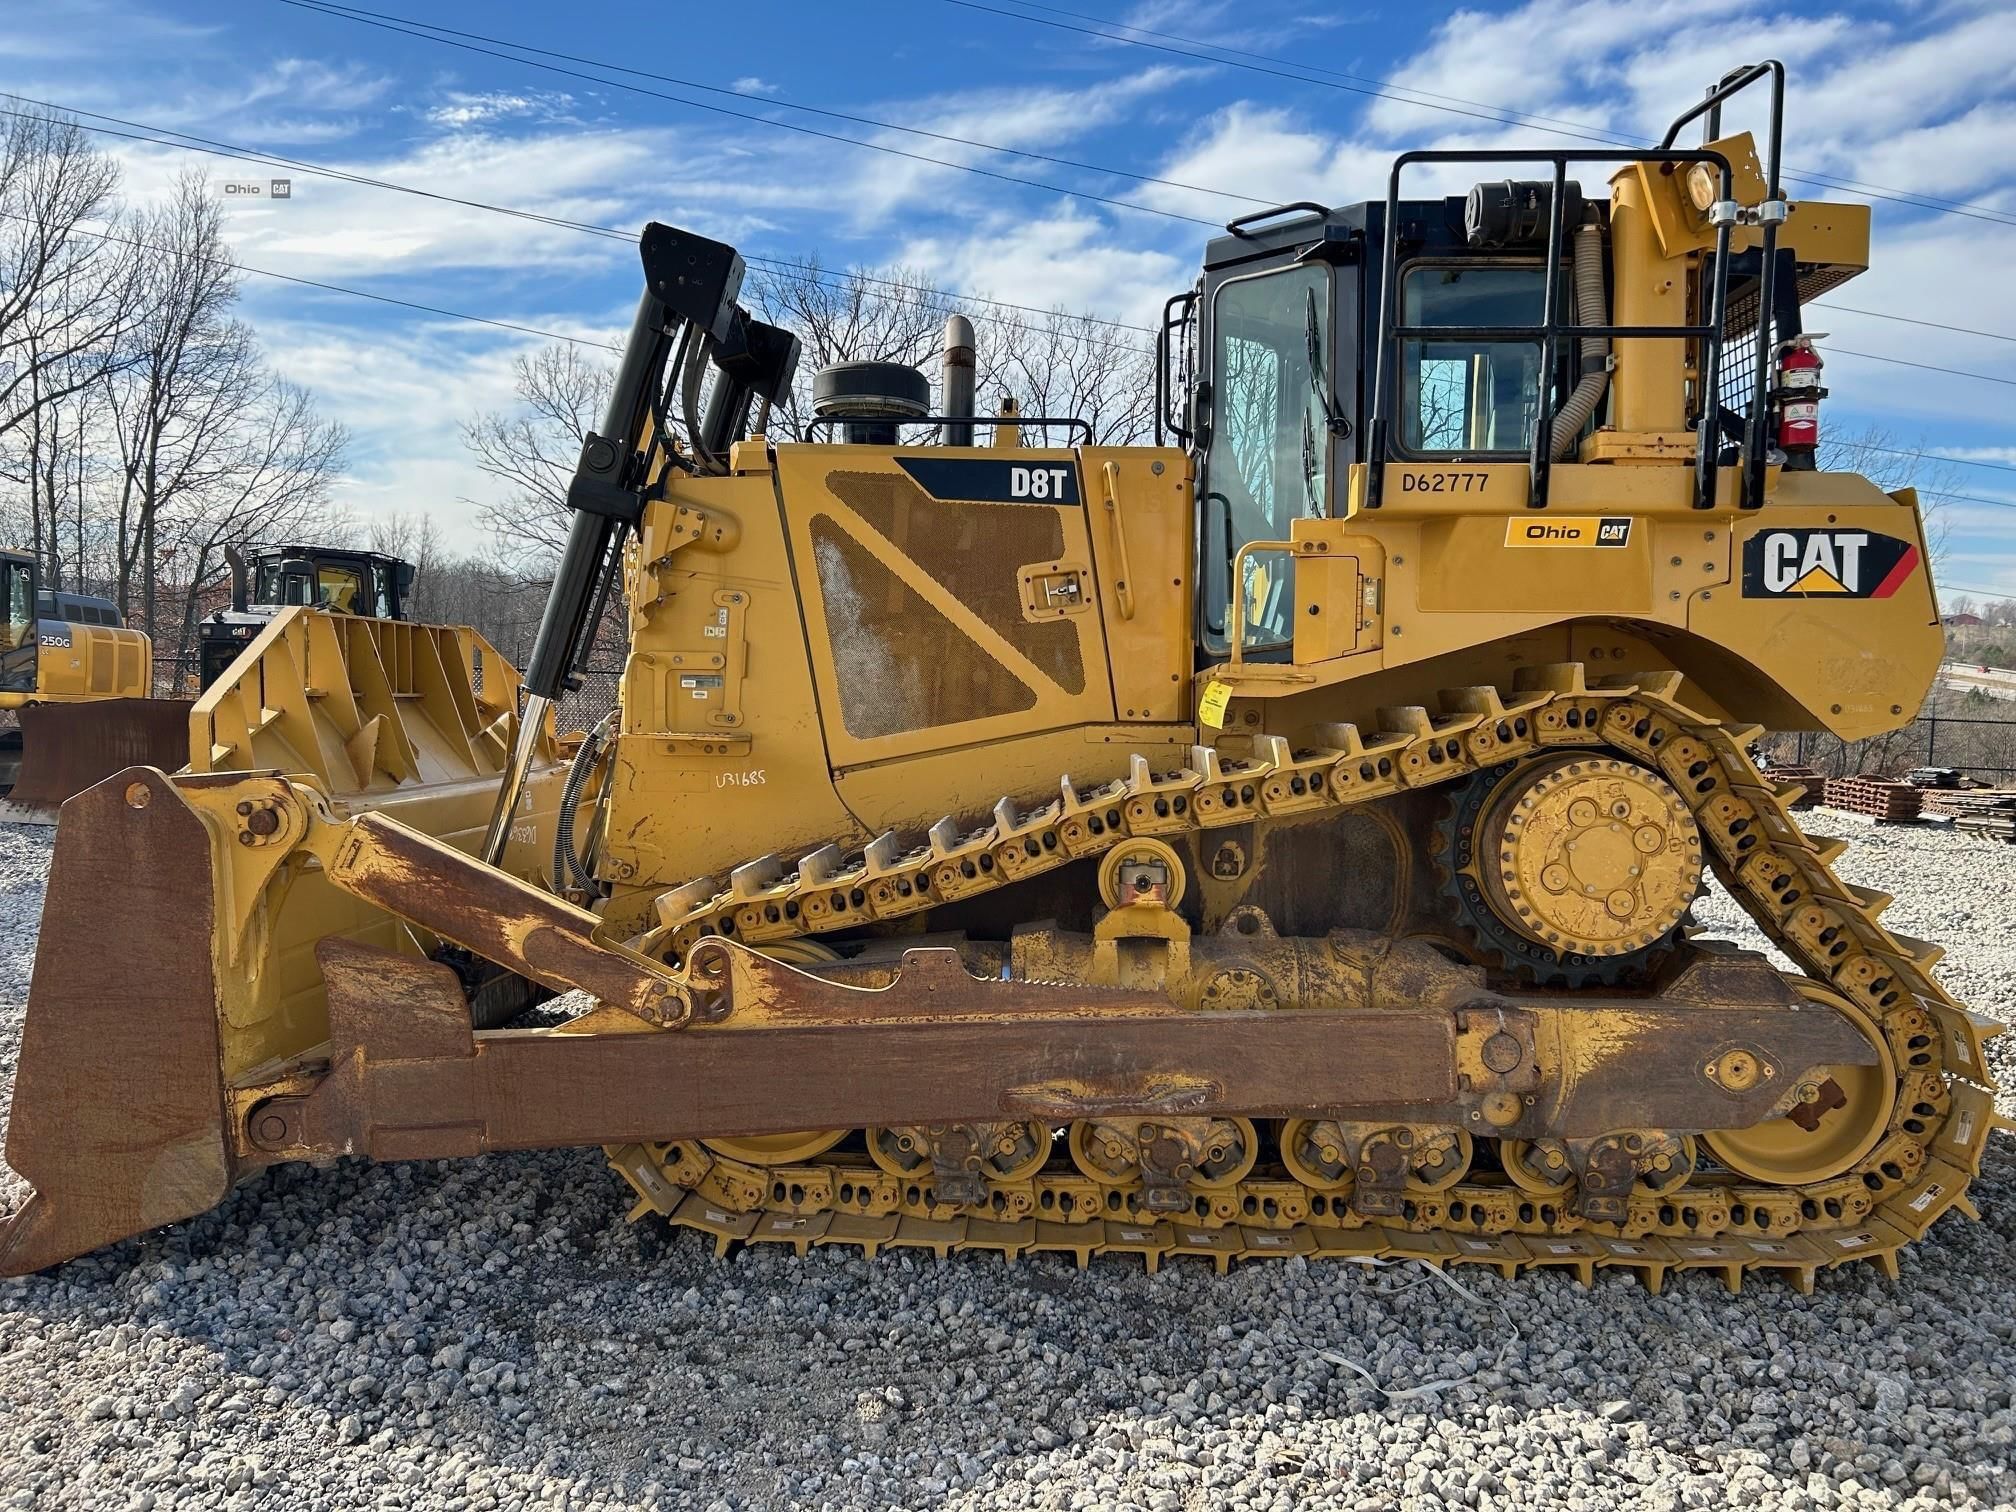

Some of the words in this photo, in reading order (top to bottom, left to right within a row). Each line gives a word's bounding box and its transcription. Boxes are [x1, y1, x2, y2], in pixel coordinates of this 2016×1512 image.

[1011, 467, 1068, 499] D8T
[1402, 473, 1489, 492] D62777
[1526, 525, 1581, 539] Ohio
[1600, 524, 1628, 540] CAT
[1764, 532, 1868, 593] CAT
[232, 626, 247, 636] CAT
[41, 635, 70, 648] 250G
